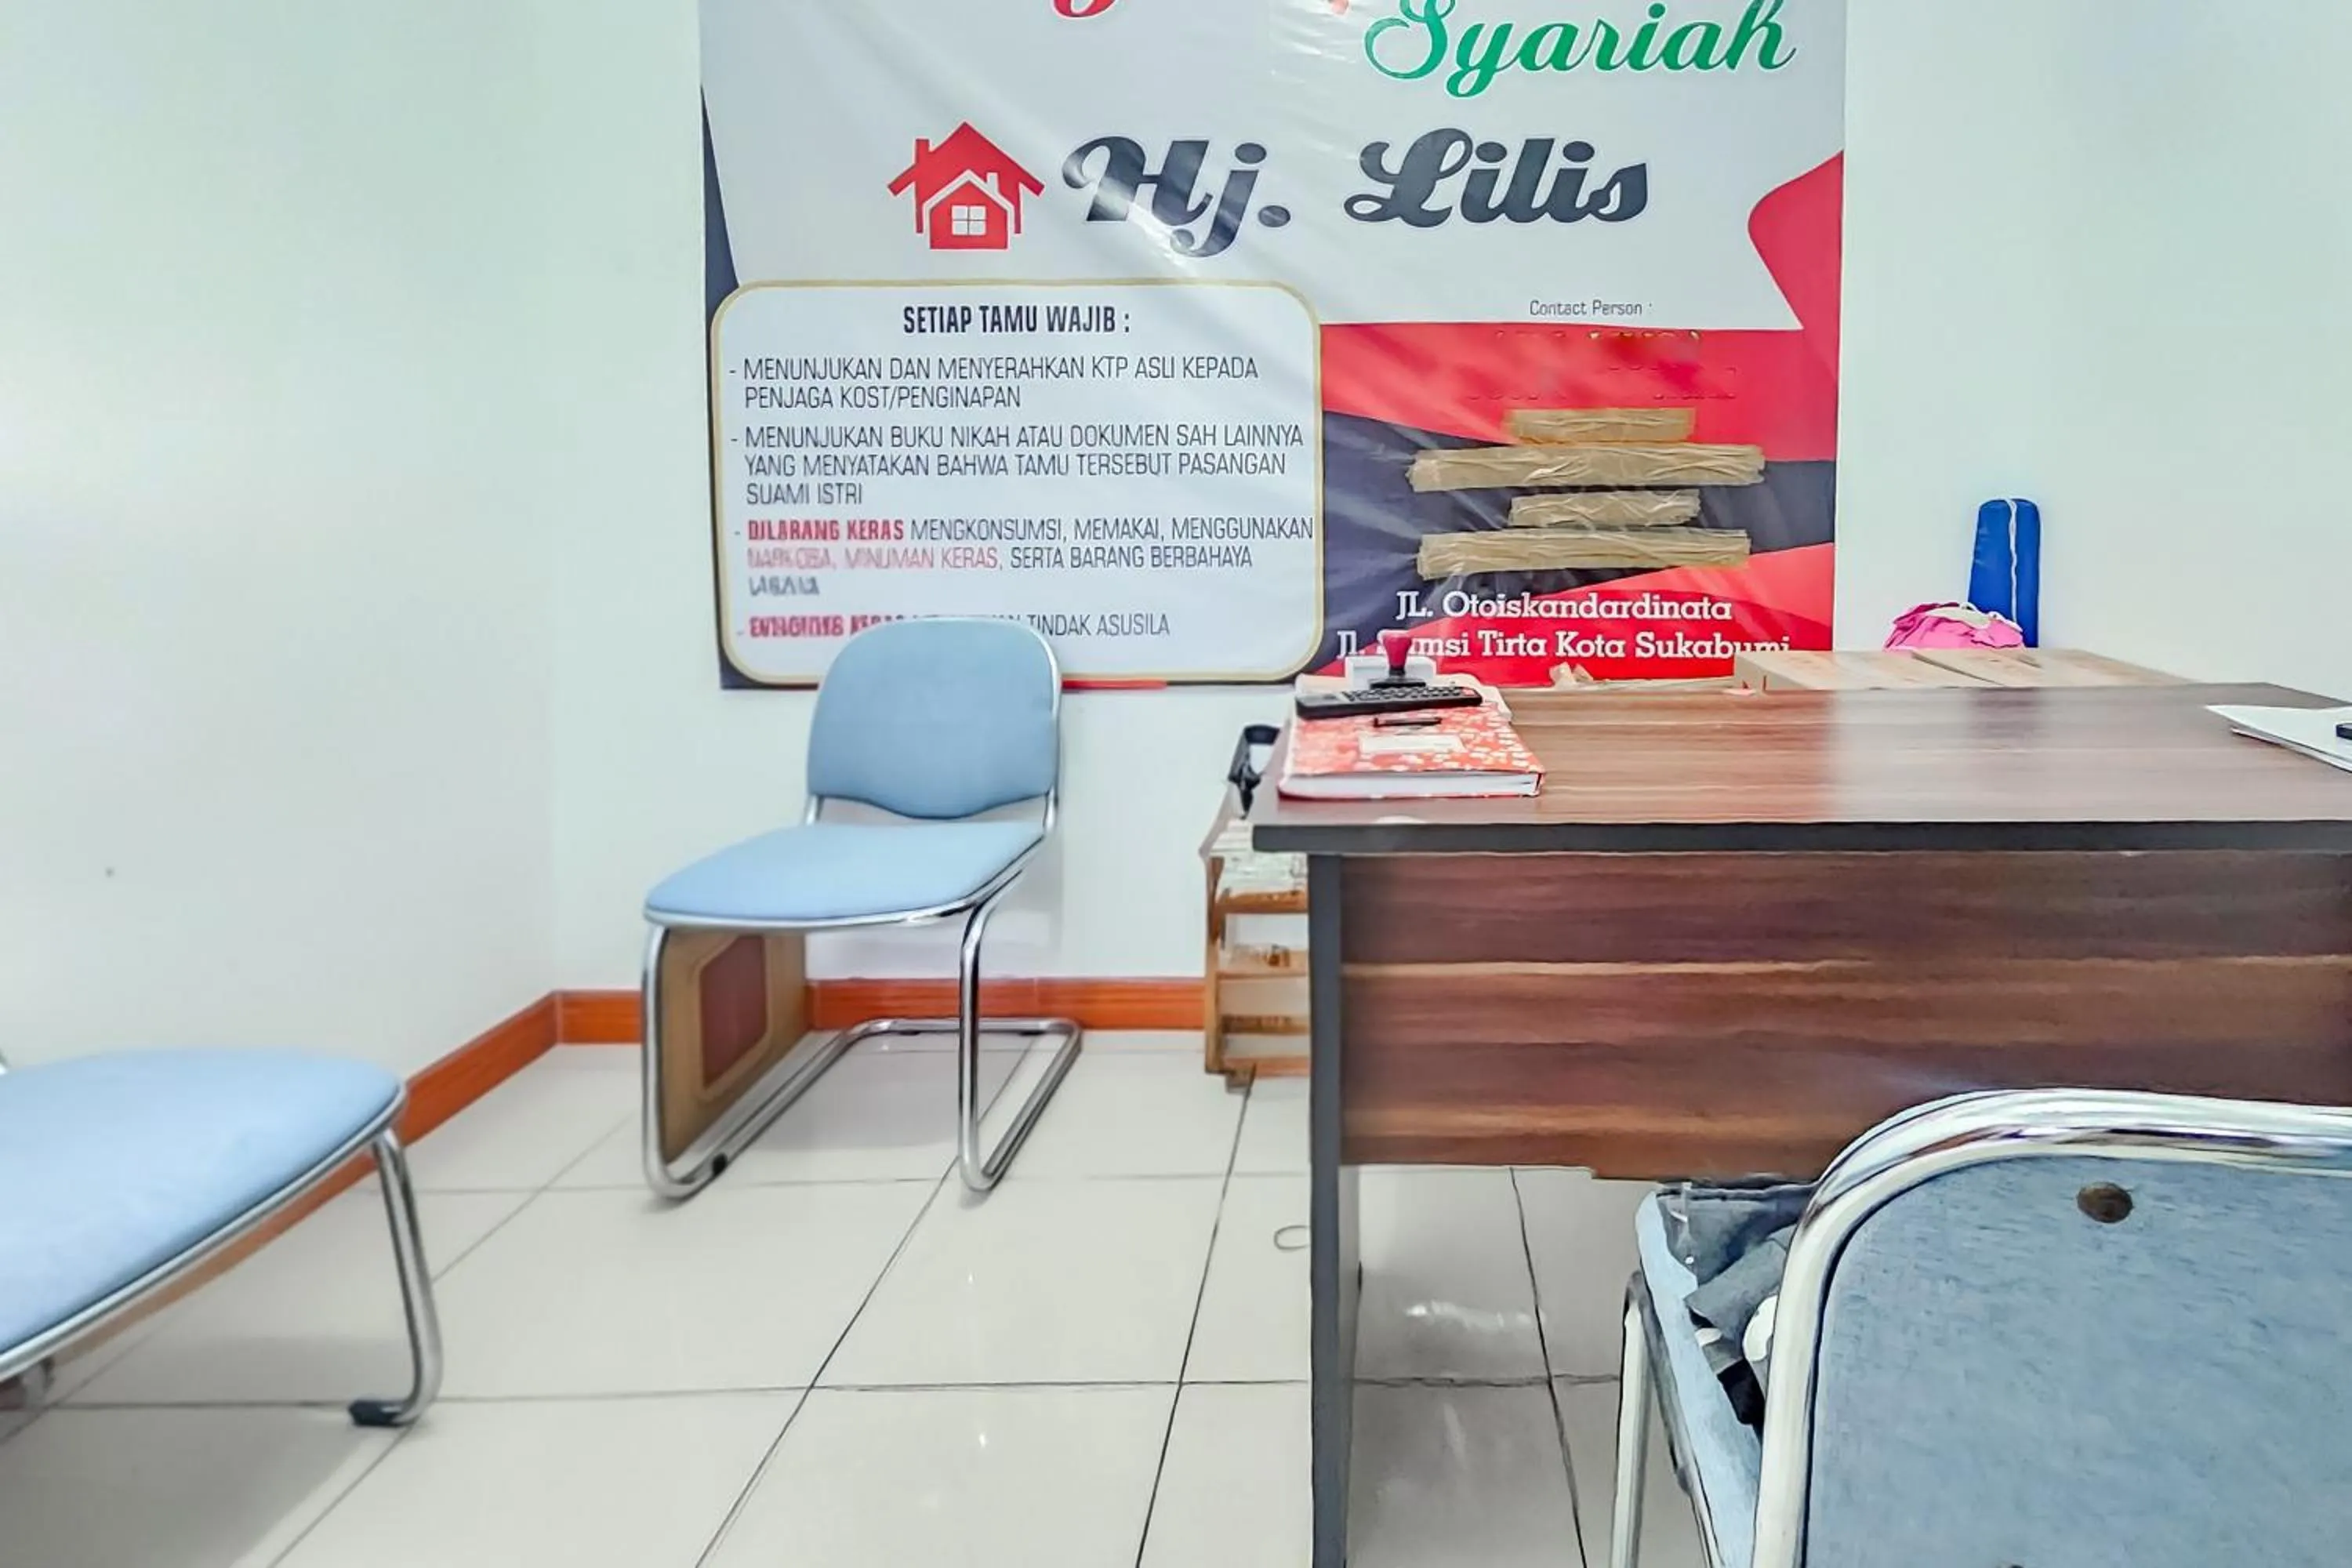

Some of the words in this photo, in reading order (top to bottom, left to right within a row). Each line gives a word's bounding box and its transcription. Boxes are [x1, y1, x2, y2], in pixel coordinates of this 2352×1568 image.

[1364, 0, 1796, 98] Syariah
[1062, 136, 1291, 257] Hj.
[1343, 128, 1648, 228] Lilis
[903, 306, 972, 333] SETIAP
[980, 305, 1037, 333] TAMU
[1046, 305, 1116, 332] WAJIB
[1530, 300, 1587, 315] Contact
[1592, 299, 1642, 315] Person
[744, 358, 882, 379] MENUNJUKAN
[890, 358, 931, 379] DAN
[938, 357, 1084, 379] MENYERAHKAN
[1092, 357, 1128, 379] KTP
[1134, 357, 1174, 379] ASLI
[1182, 356, 1258, 379] KEPADA
[745, 387, 833, 408] PENJAGA
[840, 386, 1021, 411] KOST/PENGINAPAN
[746, 426, 883, 448] MENUNJUKAN
[891, 426, 943, 448] BUKU
[951, 426, 1009, 448] NIKAH
[1016, 425, 1063, 448] ATAU
[1070, 424, 1169, 447] DOKUMEN
[1176, 424, 1216, 447] SAH
[1224, 424, 1304, 447] LAINNYA
[745, 455, 795, 477] YANG
[803, 455, 929, 477] MENYATAKAN
[937, 454, 1009, 476] BAHWA
[1015, 454, 1069, 476] TAMU
[1077, 453, 1172, 476] TERSEBUT
[1178, 453, 1286, 475] PASANGAN
[746, 482, 809, 504] SUAMI
[818, 482, 863, 504] ISTRI
[847, 520, 904, 541] KERAS
[910, 518, 1067, 543] MENGKONSUMSI,
[1074, 518, 1165, 542] MEMAKAI,
[1172, 517, 1313, 540] MENGGUNAKAN
[941, 546, 1003, 571] KERAS,
[1010, 547, 1064, 569] SERTA
[1070, 546, 1145, 569] BARANG
[1150, 546, 1252, 568] BERBAHAYA
[1396, 590, 1433, 619] JL.
[1443, 590, 1732, 620] Otoiskandardinata
[1026, 614, 1091, 636] TINDAK
[1097, 614, 1170, 636] ASUSILA
[1478, 630, 1547, 657] Tirta
[1555, 632, 1625, 657] Kota
